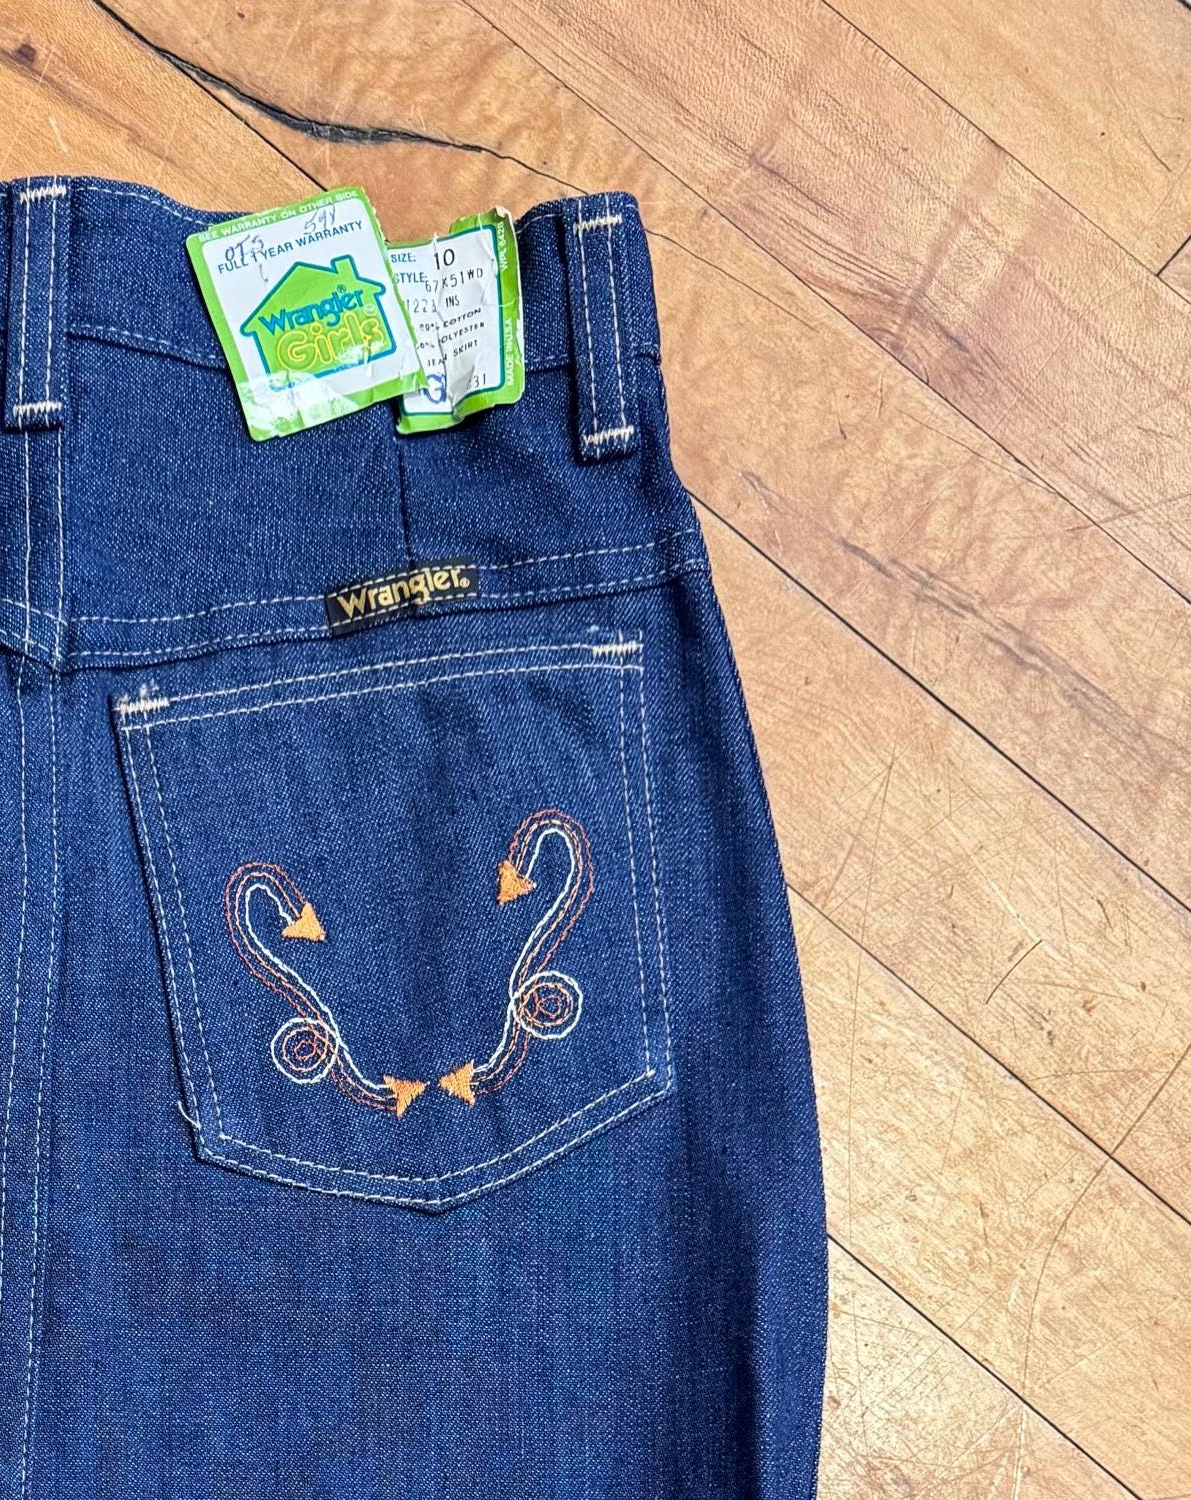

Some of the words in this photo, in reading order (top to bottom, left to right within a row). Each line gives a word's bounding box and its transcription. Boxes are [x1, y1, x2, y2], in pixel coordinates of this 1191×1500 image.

[221, 214, 278, 237] WARRANTY
[281, 209, 297, 220] ON
[299, 198, 333, 213] OTHER
[335, 191, 358, 202] SIDE
[217, 255, 250, 275] FULL
[260, 241, 295, 260] YEAR
[296, 220, 363, 248] WARRANTY
[390, 252, 417, 264] SIZE:
[434, 248, 455, 271] 10
[499, 248, 509, 272] WPL
[258, 289, 364, 336] Wrangler
[443, 307, 482, 328] COTTON
[277, 311, 385, 371] Girls
[453, 339, 478, 357] SKIRT
[505, 353, 514, 386] MADE
[337, 567, 461, 619] Wrangler
